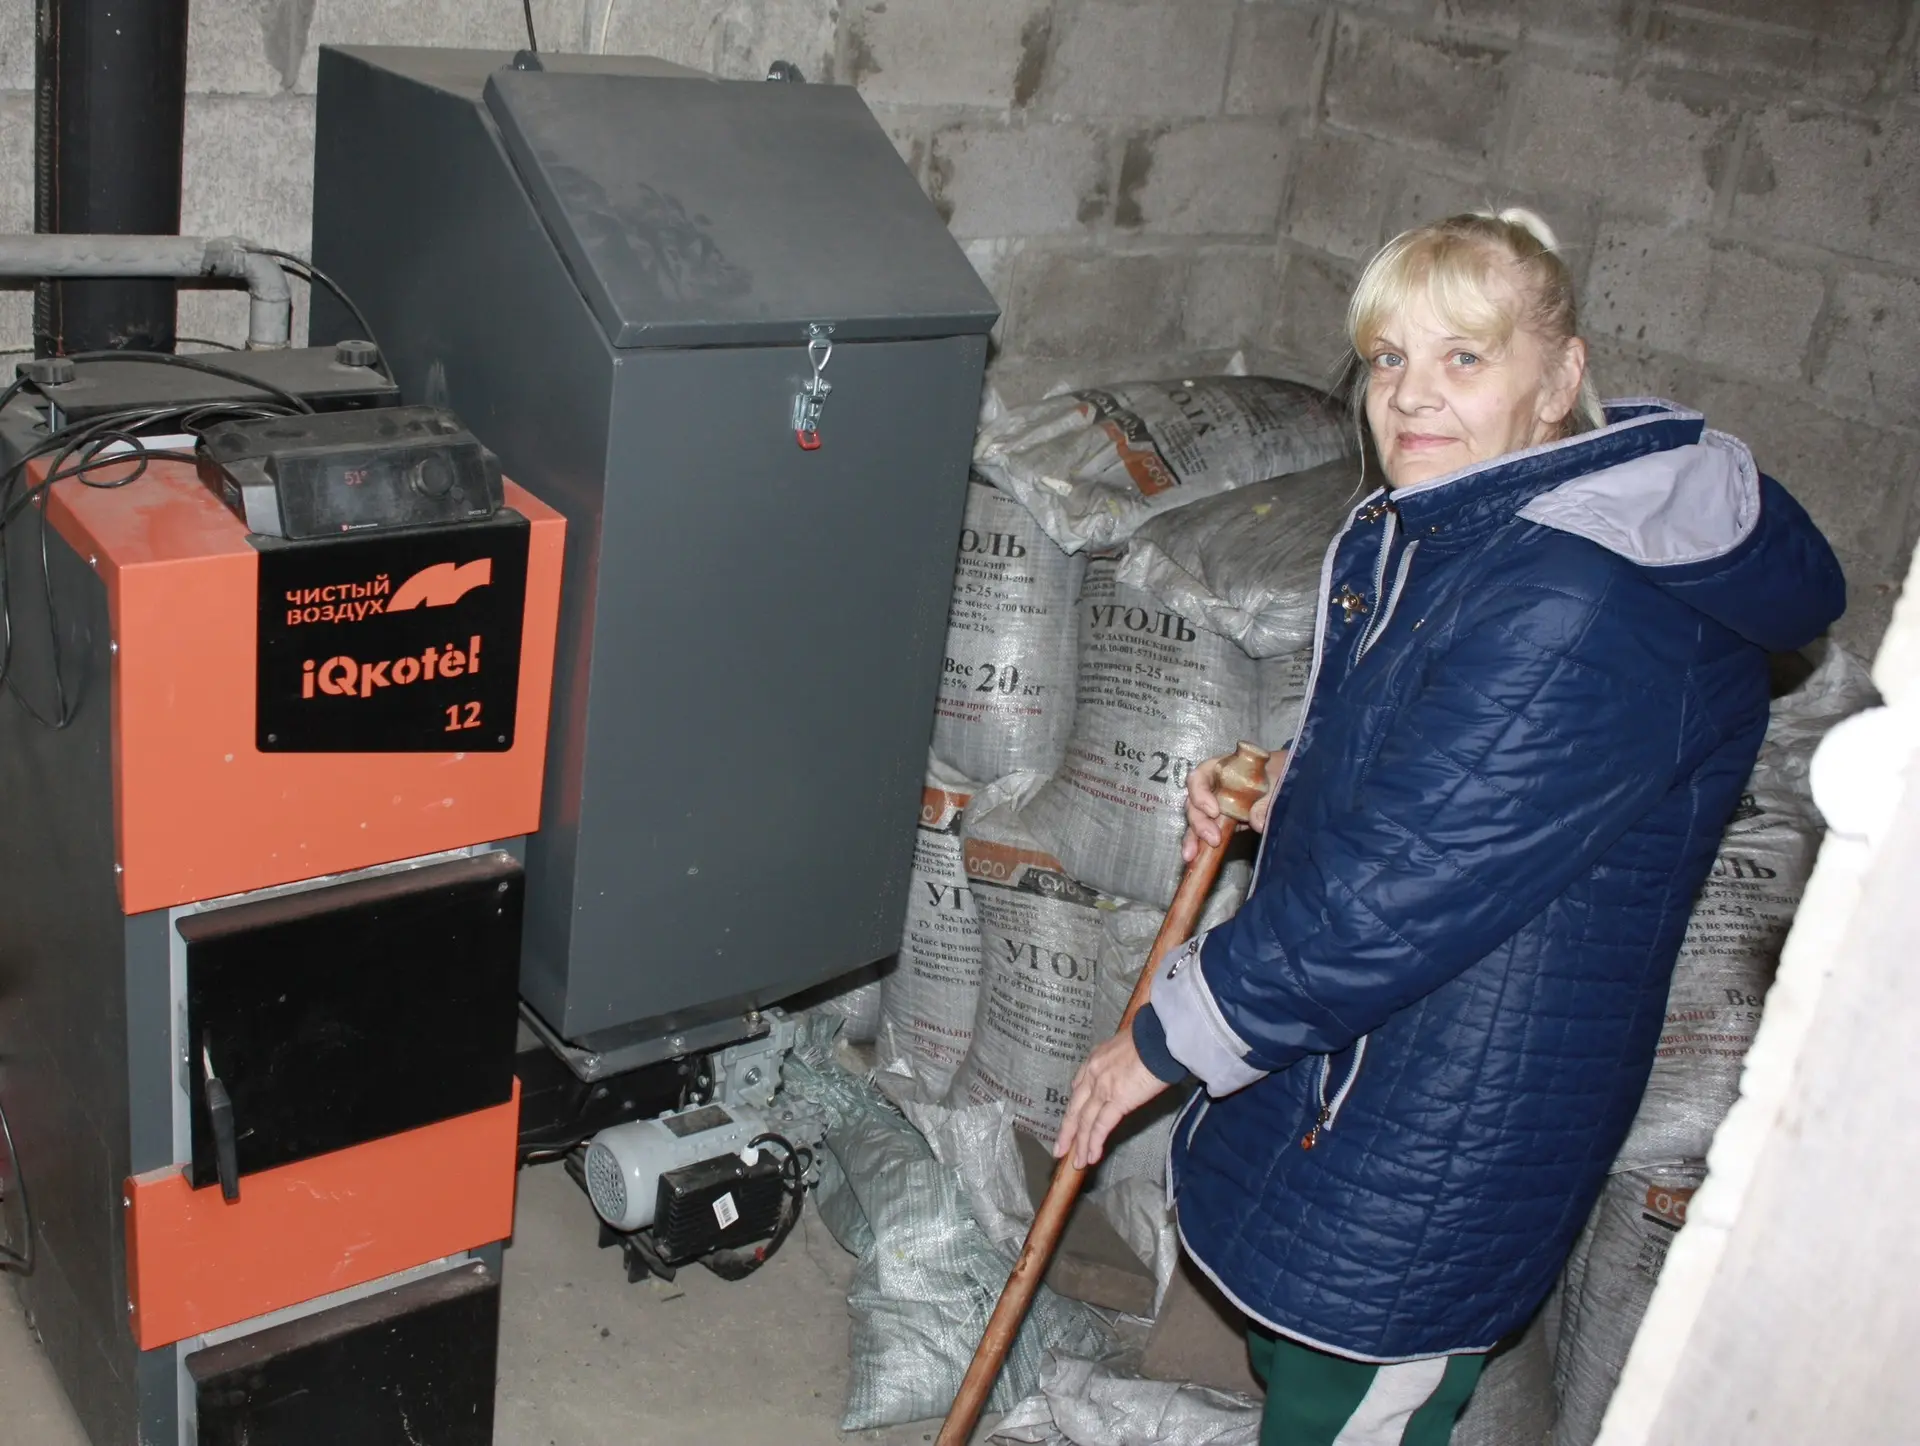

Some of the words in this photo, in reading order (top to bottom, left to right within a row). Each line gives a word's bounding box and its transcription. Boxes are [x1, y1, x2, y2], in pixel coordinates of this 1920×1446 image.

[959, 528, 1026, 558] ОЛЬ
[285, 573, 390, 606] ЧИСТЫЙ
[286, 599, 385, 626] ВОЗДУХ
[1090, 605, 1197, 643] УГОЛЬ
[944, 656, 974, 677] Вес
[975, 663, 1019, 695] 20
[1135, 663, 1162, 680] 5-25
[444, 701, 481, 732] 12
[1114, 740, 1146, 763] Вес
[968, 857, 1006, 878] ООО
[1003, 937, 1097, 982] УГОЛ
[1045, 1086, 1068, 1106] Ве
